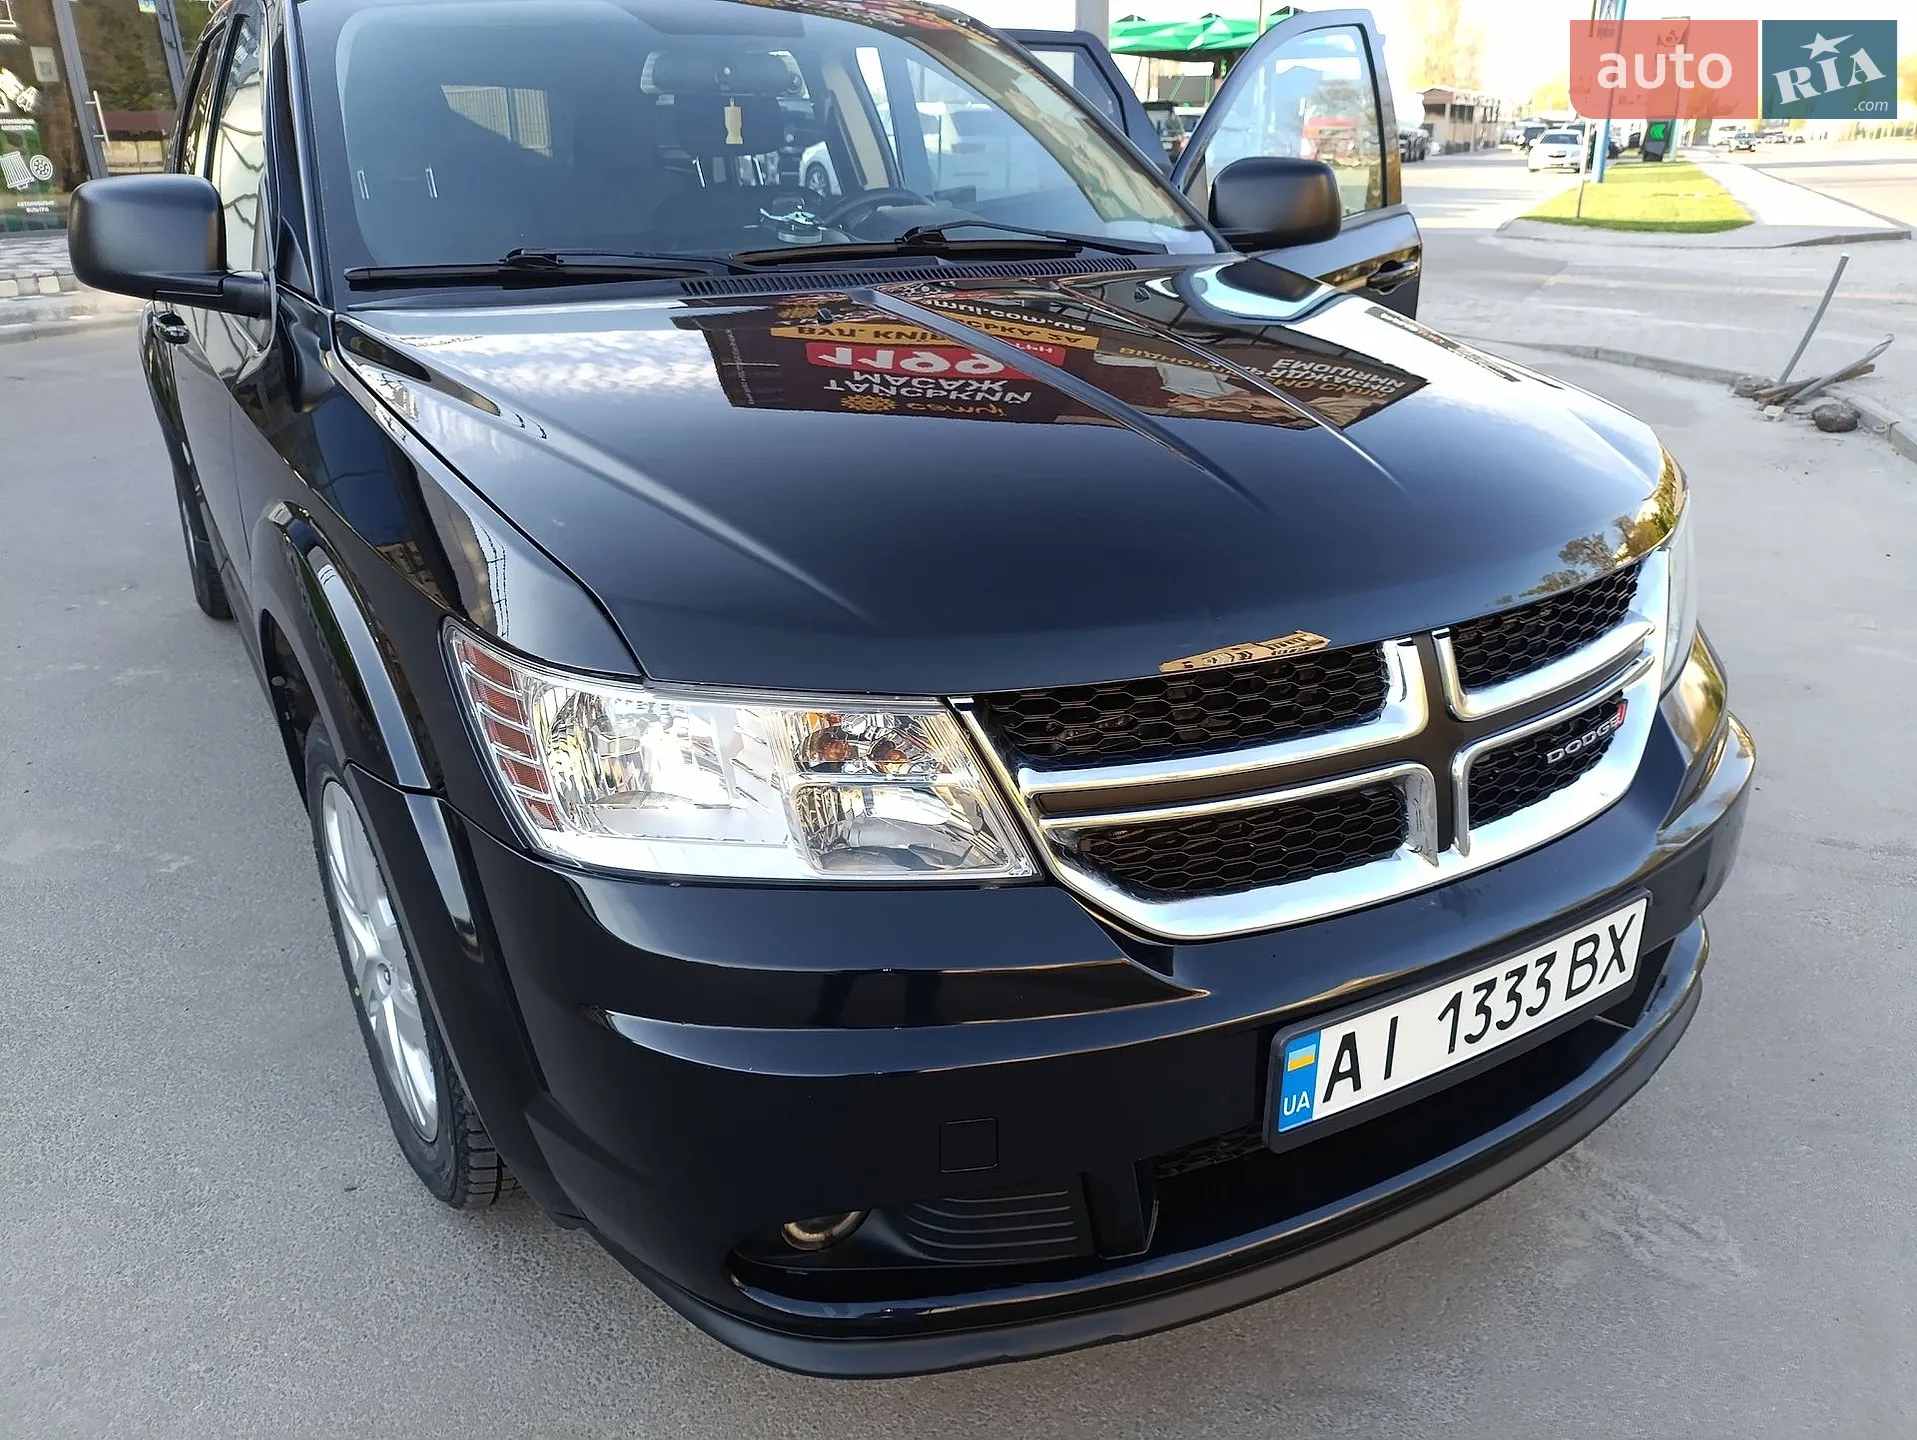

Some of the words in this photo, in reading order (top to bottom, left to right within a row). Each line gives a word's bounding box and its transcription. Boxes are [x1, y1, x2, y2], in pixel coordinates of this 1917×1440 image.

[1546, 711, 1622, 764] DODGE
[1322, 1015, 1399, 1104] AI
[1437, 950, 1557, 1055] 1333
[1565, 913, 1637, 1001] BX
[1283, 1094, 1310, 1117] UA
